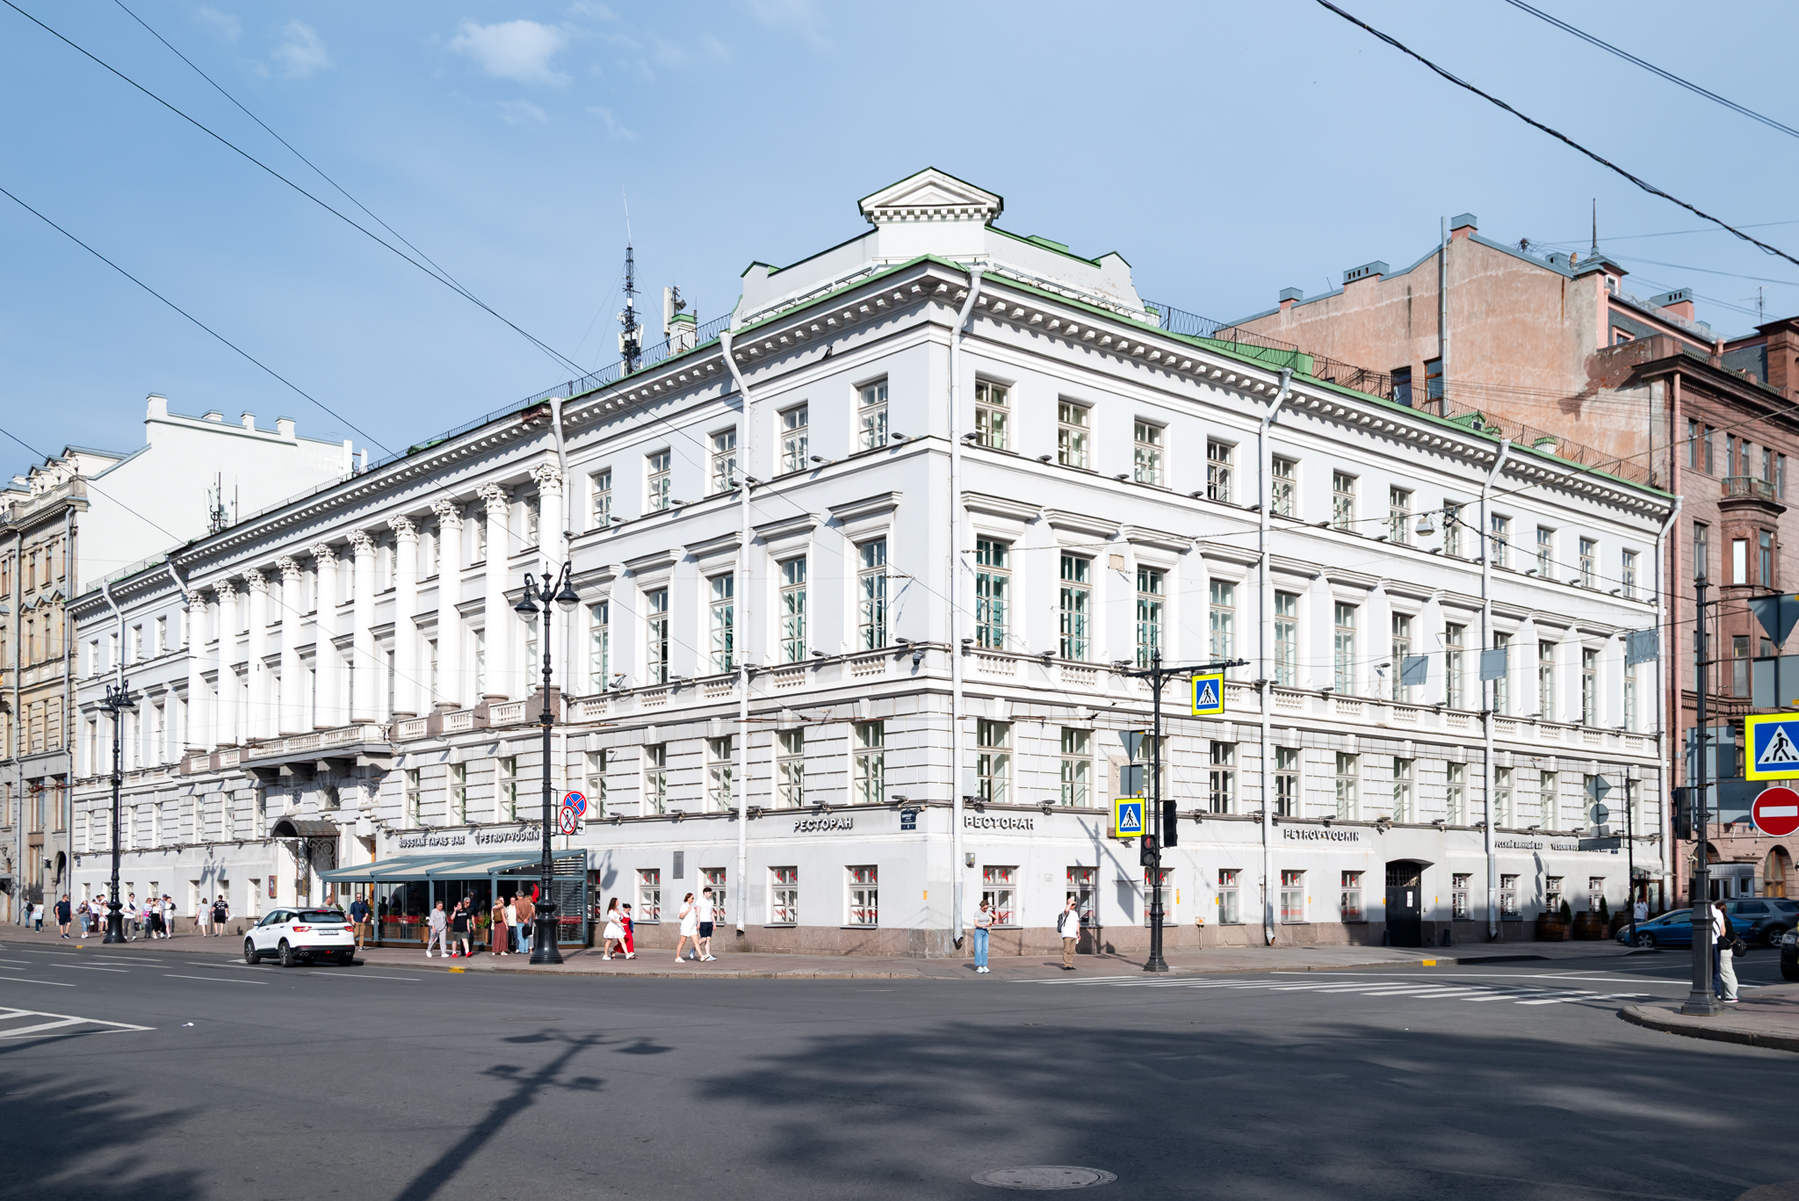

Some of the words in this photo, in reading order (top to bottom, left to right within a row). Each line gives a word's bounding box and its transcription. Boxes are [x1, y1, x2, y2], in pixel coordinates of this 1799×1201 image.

[793, 818, 853, 833] РЕСТОРАН
[964, 816, 1034, 830] РЕСТОРАН
[399, 838, 426, 848] RUSSIAN
[429, 837, 449, 847] TAPAS
[451, 836, 466, 846] BAR
